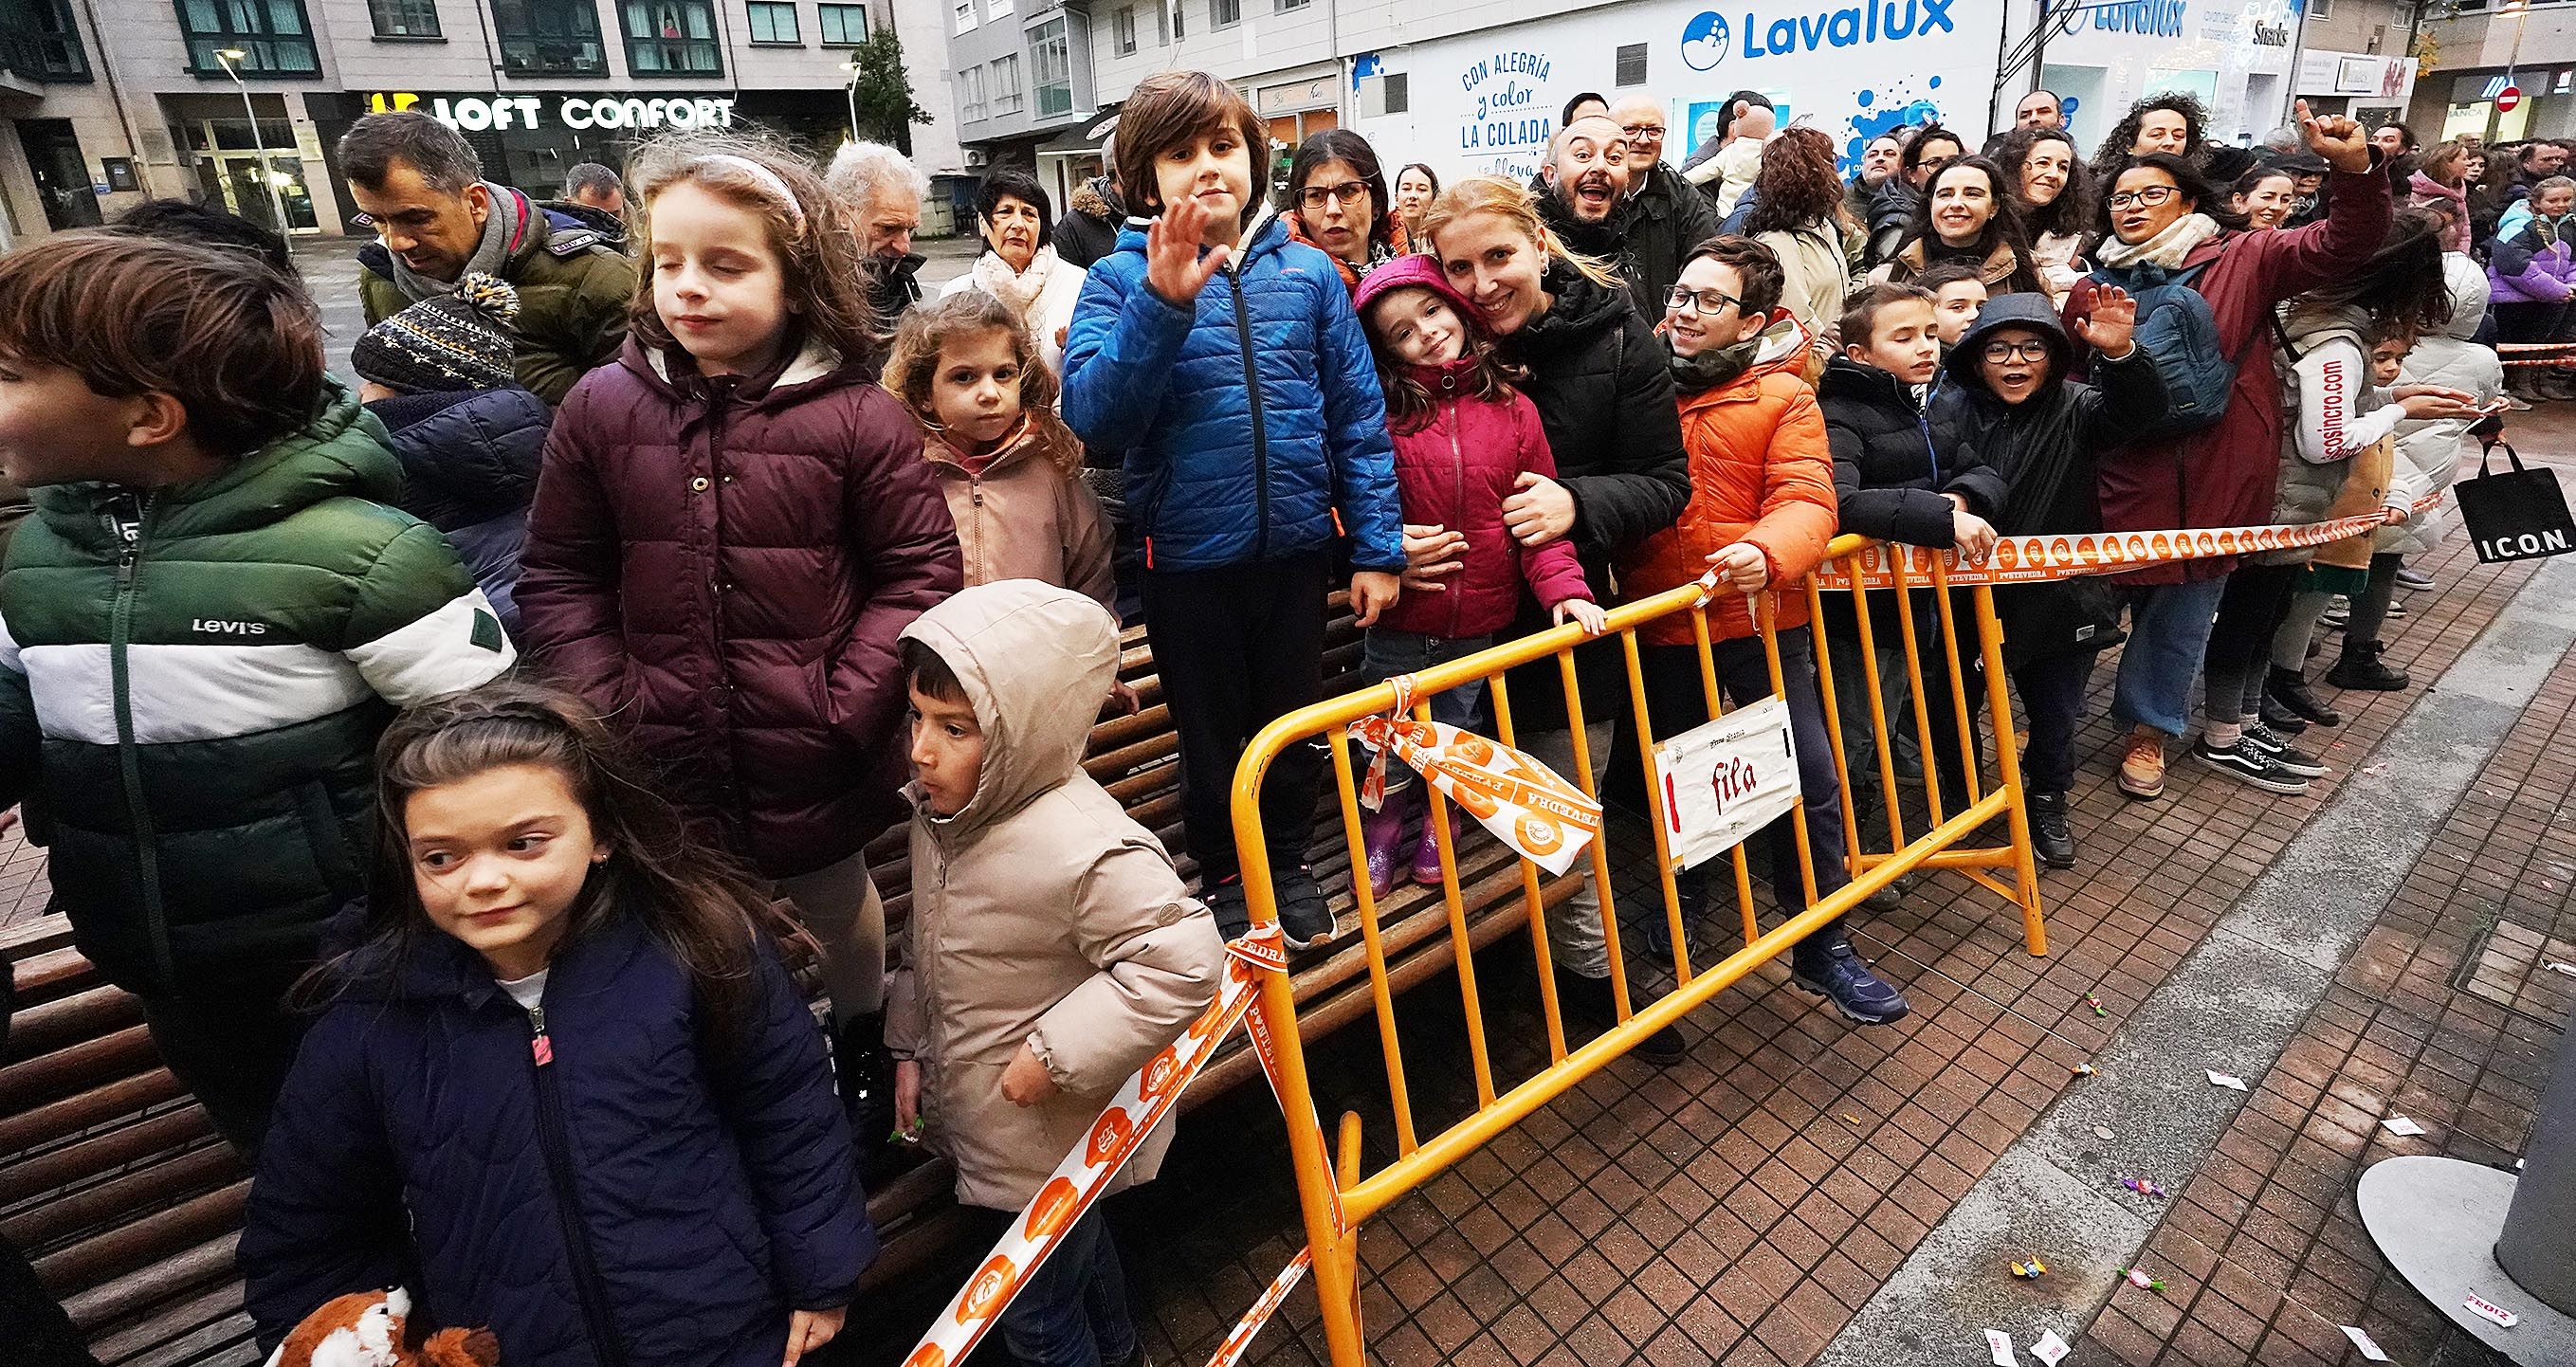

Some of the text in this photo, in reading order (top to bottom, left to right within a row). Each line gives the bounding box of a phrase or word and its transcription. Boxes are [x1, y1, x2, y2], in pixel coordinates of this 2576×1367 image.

[1744, 0, 1954, 59] Lavalux
[1462, 52, 1550, 91] CON ALEGRÍA
[432, 98, 541, 131] LOFT
[561, 98, 734, 130] CONFORT
[1478, 81, 1533, 120] y color
[1462, 118, 1550, 149] LA COLADA
[2481, 529, 2573, 560] I.C.O.N.
[1711, 756, 1757, 816] fila
[2465, 1295, 2509, 1321] FROIZ
